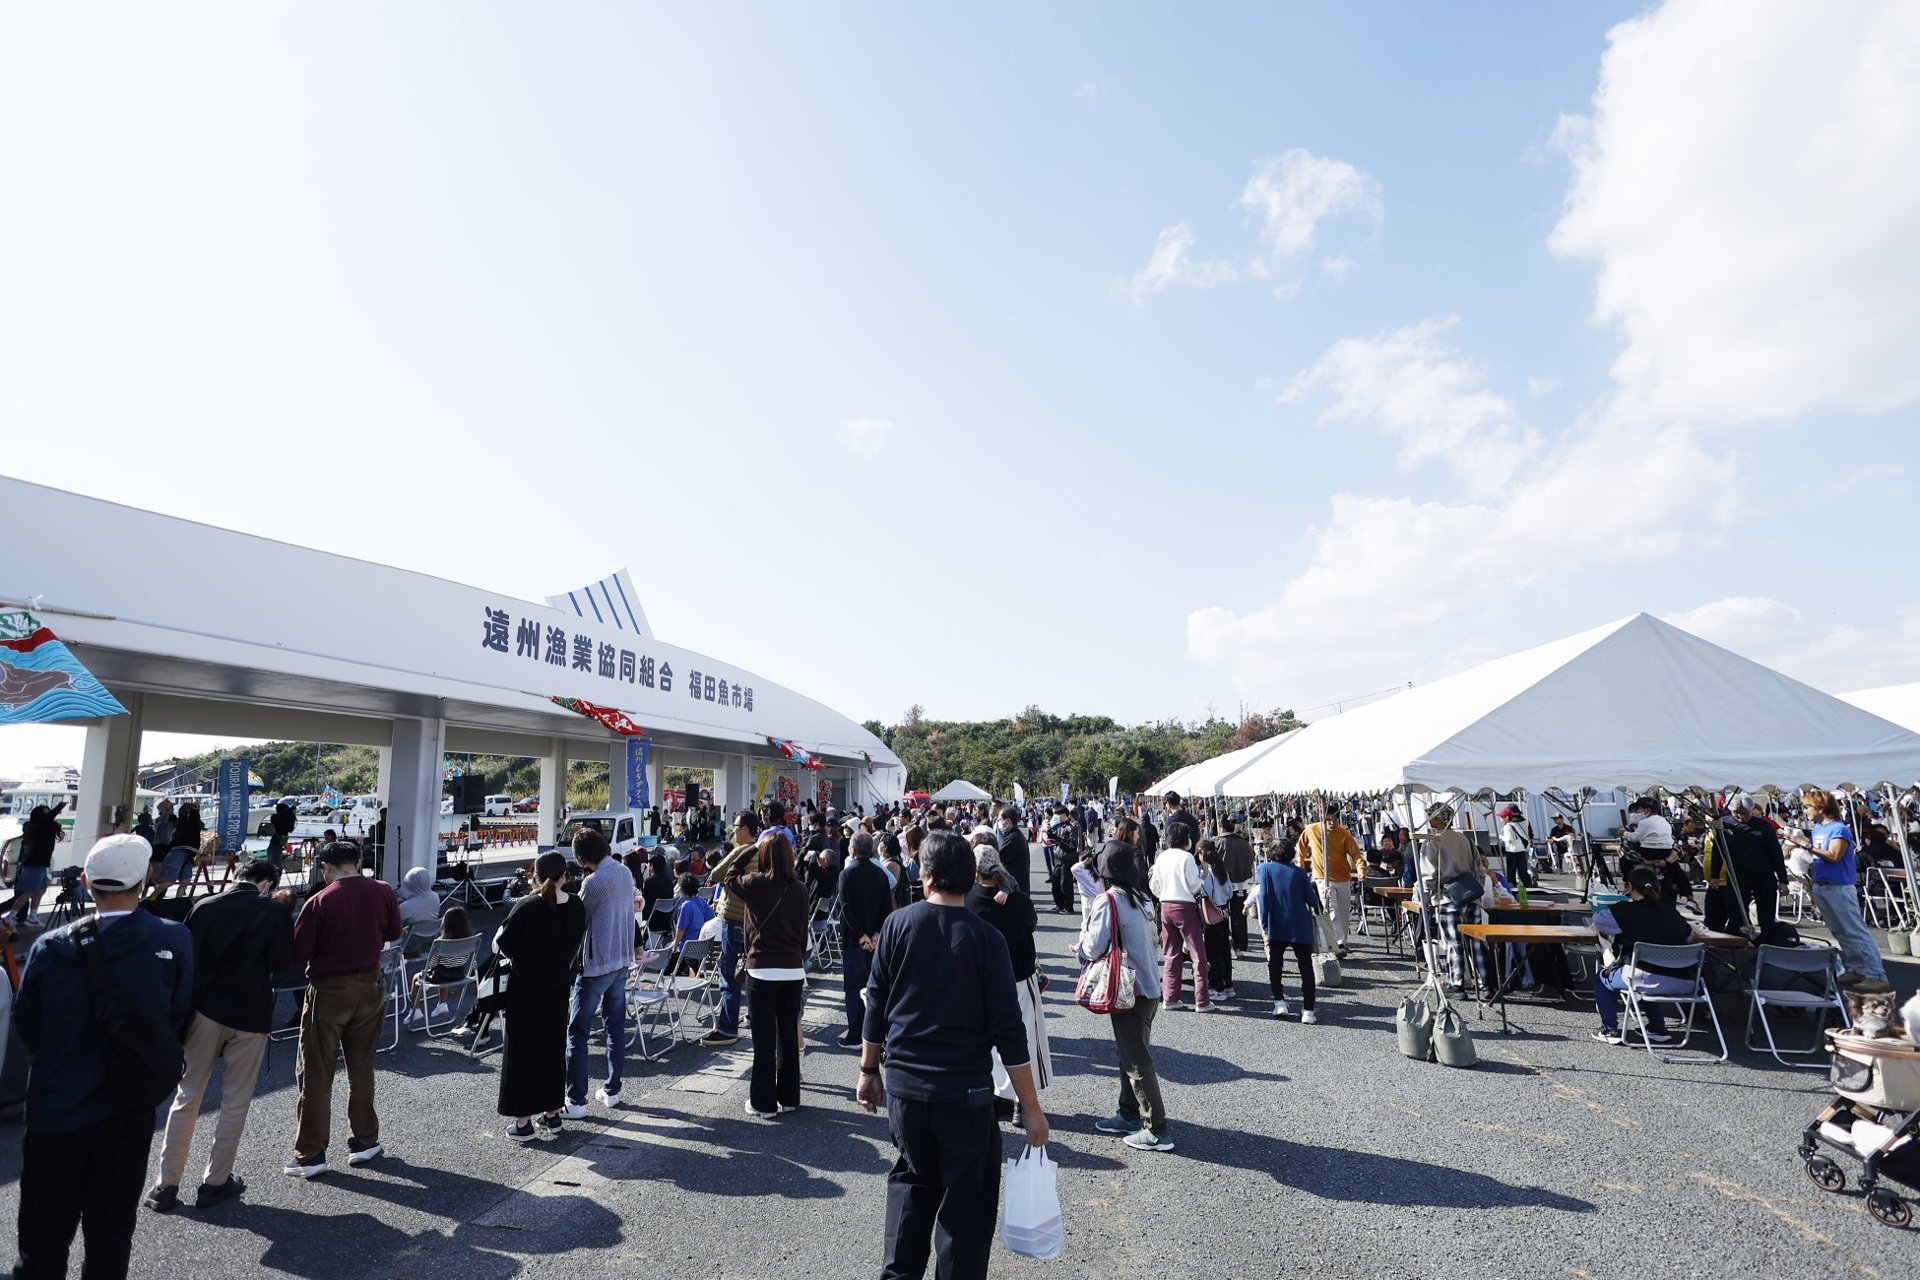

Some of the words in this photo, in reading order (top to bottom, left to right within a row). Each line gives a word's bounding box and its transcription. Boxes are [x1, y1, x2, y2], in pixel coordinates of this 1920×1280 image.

[482, 606, 674, 692] 遠州漁業協同組合
[689, 669, 754, 713] 福田魚市場
[228, 790, 241, 818] MARINE
